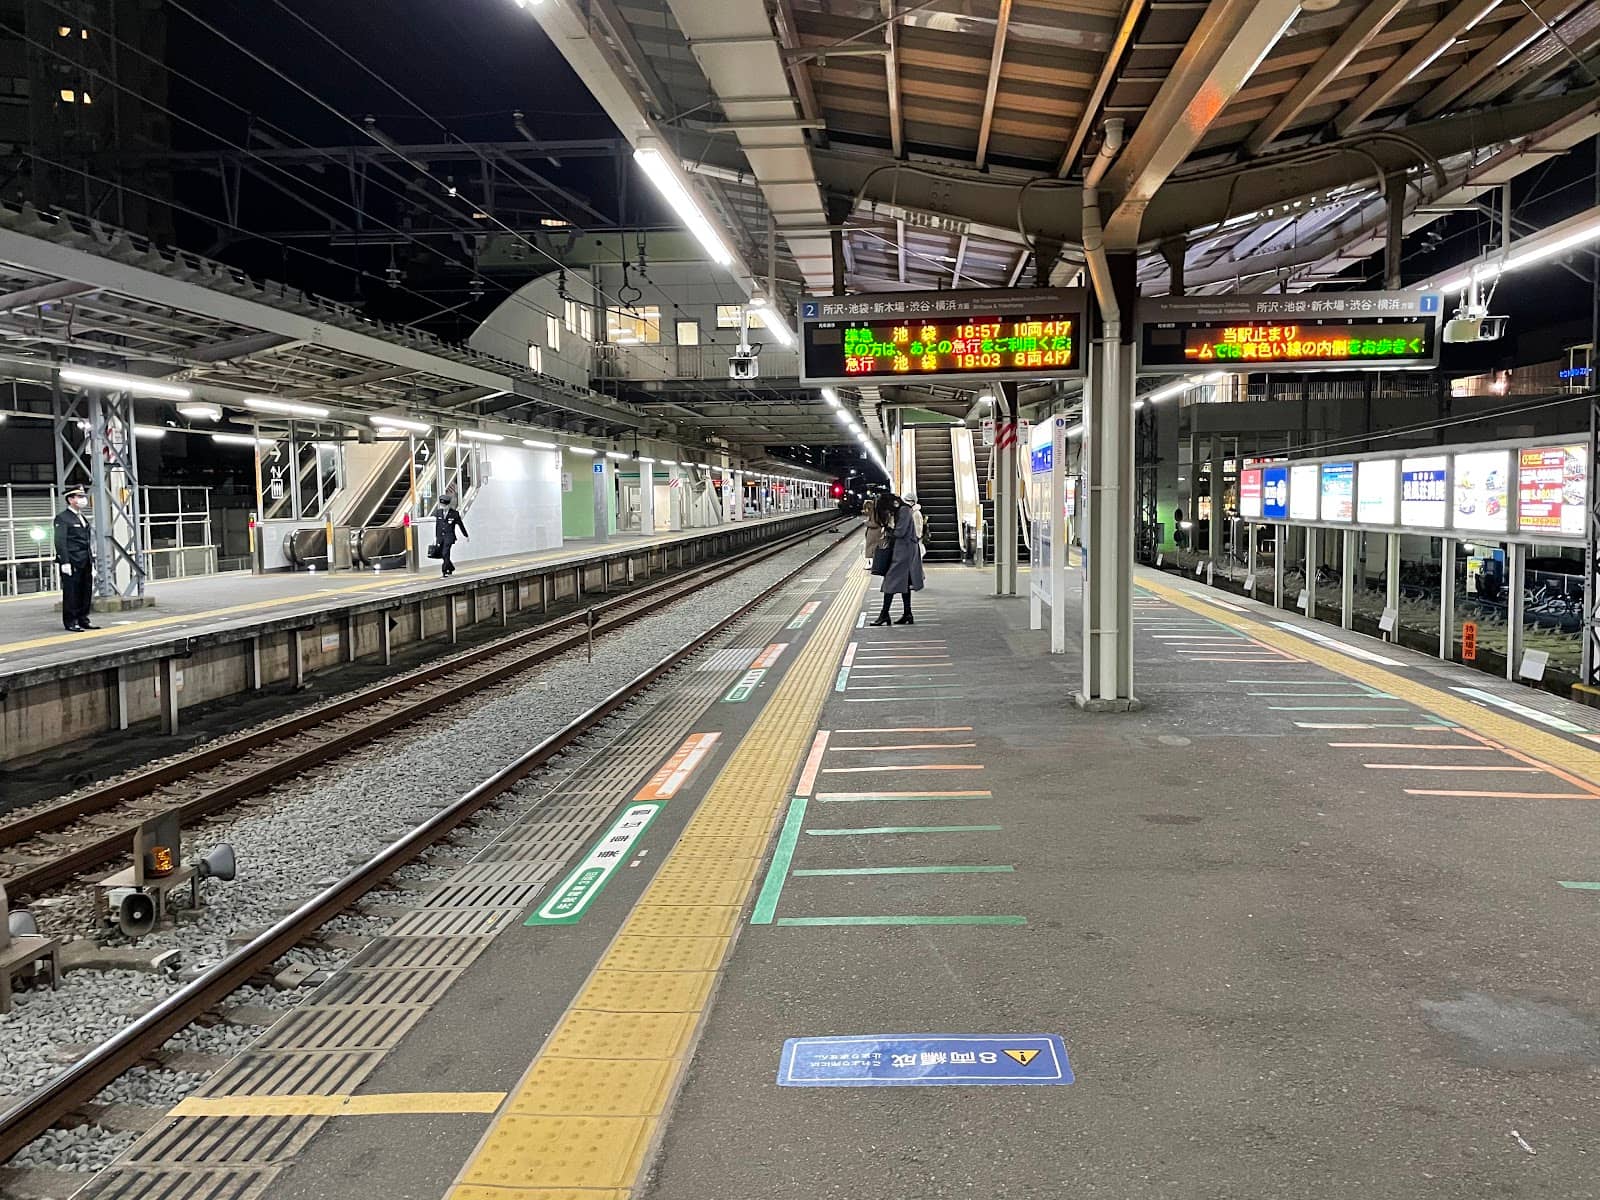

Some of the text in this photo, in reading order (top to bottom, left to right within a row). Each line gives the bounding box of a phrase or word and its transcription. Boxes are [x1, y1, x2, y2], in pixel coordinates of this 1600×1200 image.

[806, 305, 815, 316] 2
[957, 324, 1001, 338] 18:57
[1223, 326, 1297, 343] 当駅止まり
[1185, 339, 1425, 358] ームでは黄色い線の内側をお歩きく
[846, 357, 874, 372] 急行
[957, 353, 1001, 367] 19:03
[891, 1051, 997, 1068] 8両編成
